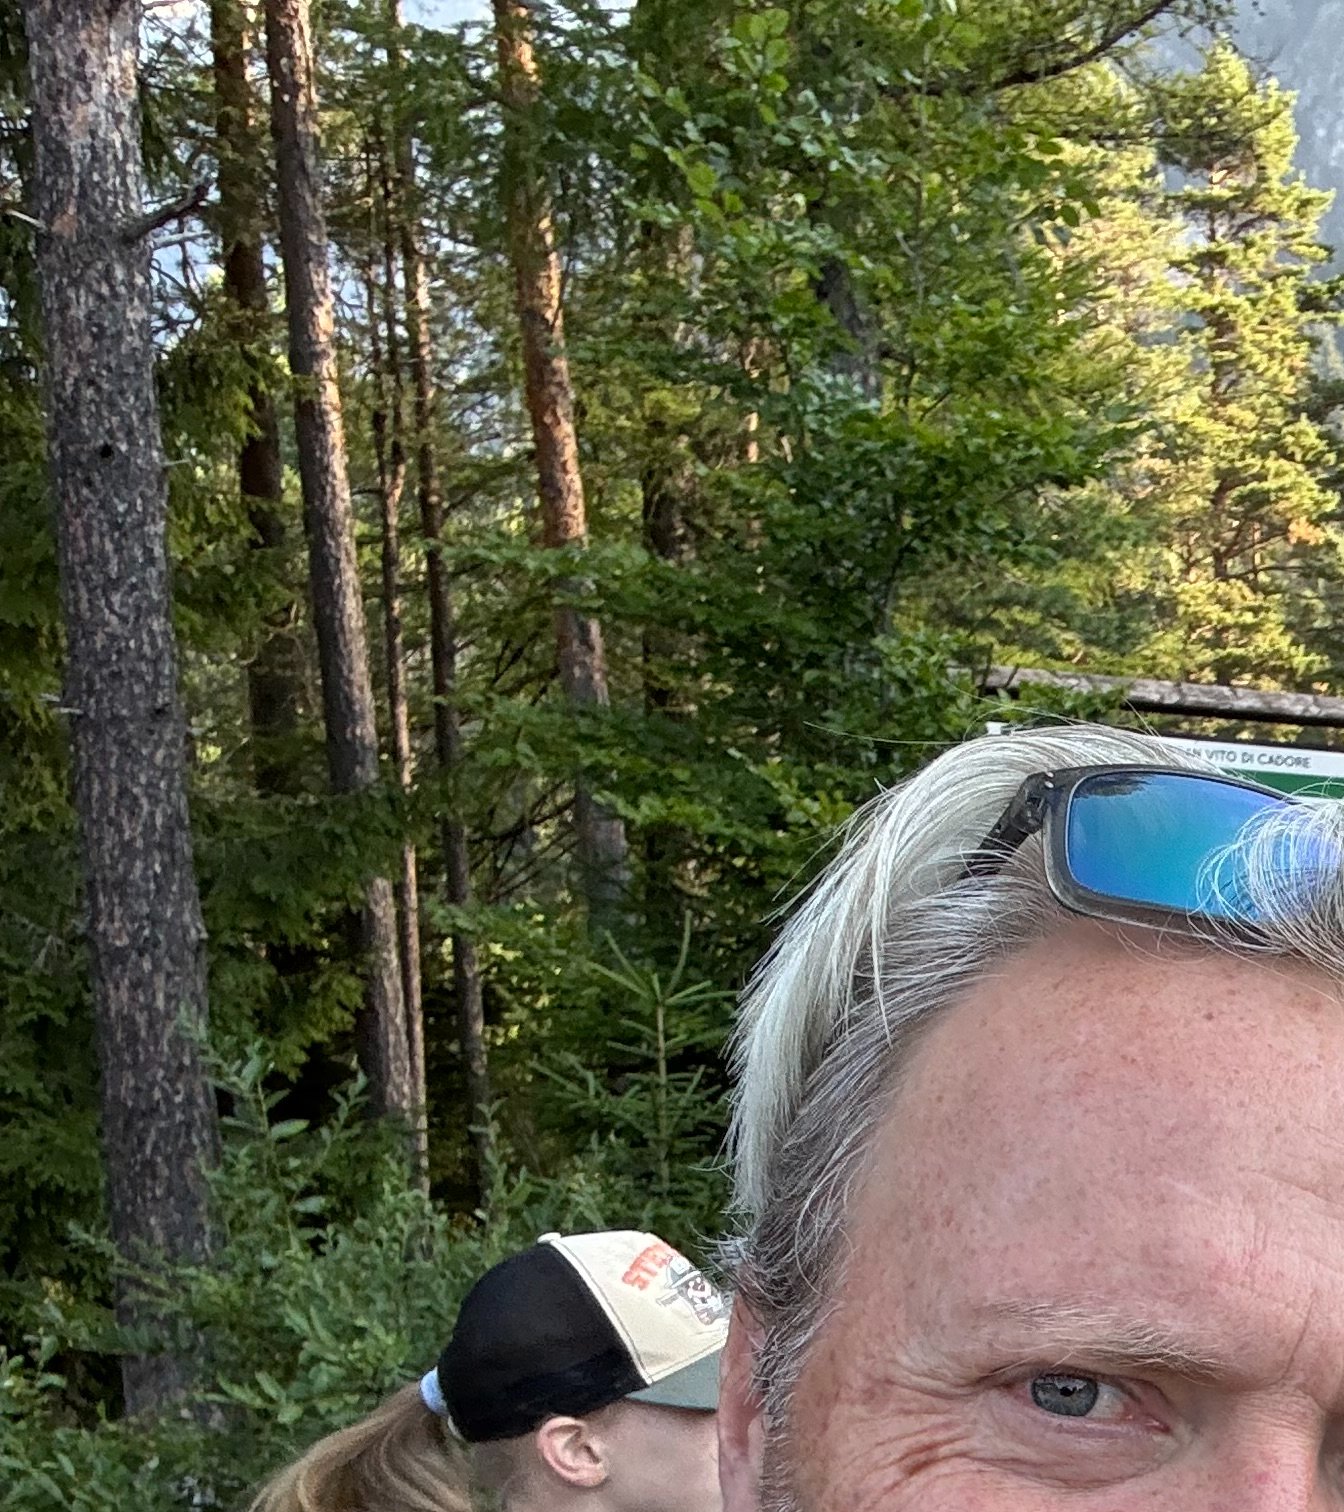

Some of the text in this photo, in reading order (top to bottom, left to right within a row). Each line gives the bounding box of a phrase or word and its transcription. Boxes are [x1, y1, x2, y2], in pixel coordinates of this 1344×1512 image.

[1205, 748, 1237, 763] VITO
[1241, 750, 1253, 764] DI
[1256, 752, 1312, 769] CADORE
